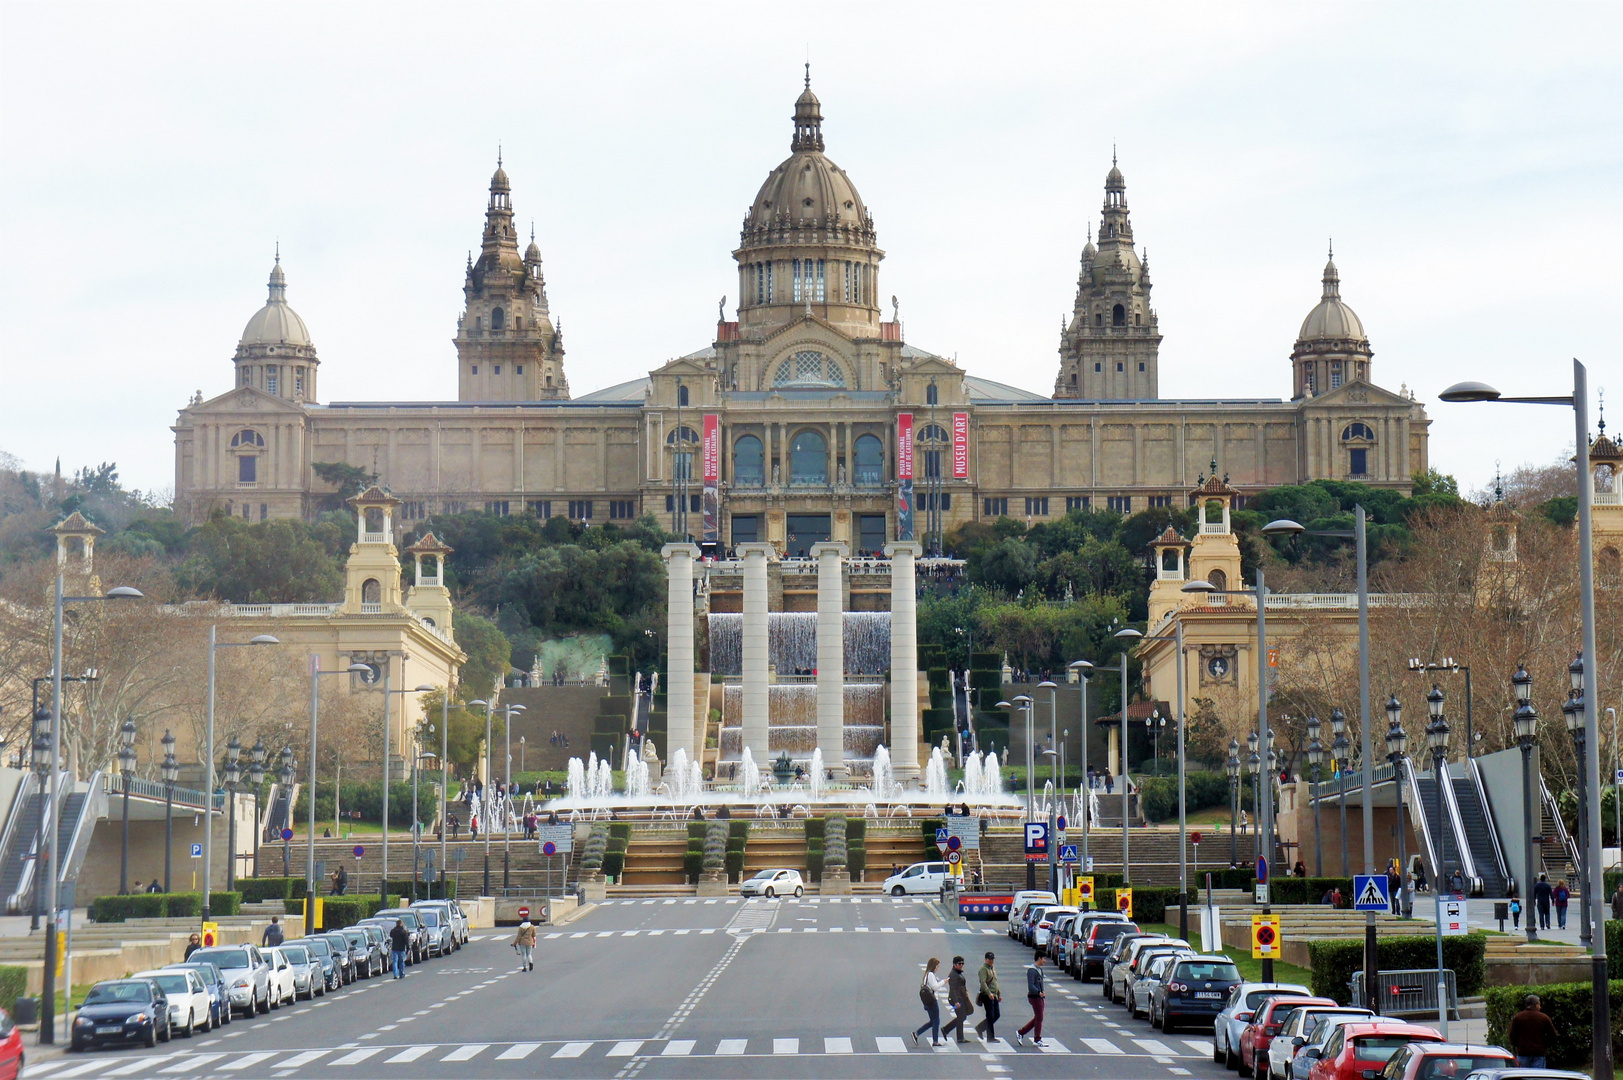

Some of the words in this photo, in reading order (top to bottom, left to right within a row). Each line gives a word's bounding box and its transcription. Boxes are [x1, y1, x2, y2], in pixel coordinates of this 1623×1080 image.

[956, 416, 966, 442] D'ART
[956, 446, 966, 474] MUSEU
[1027, 825, 1045, 847] P
[193, 845, 200, 854] P
